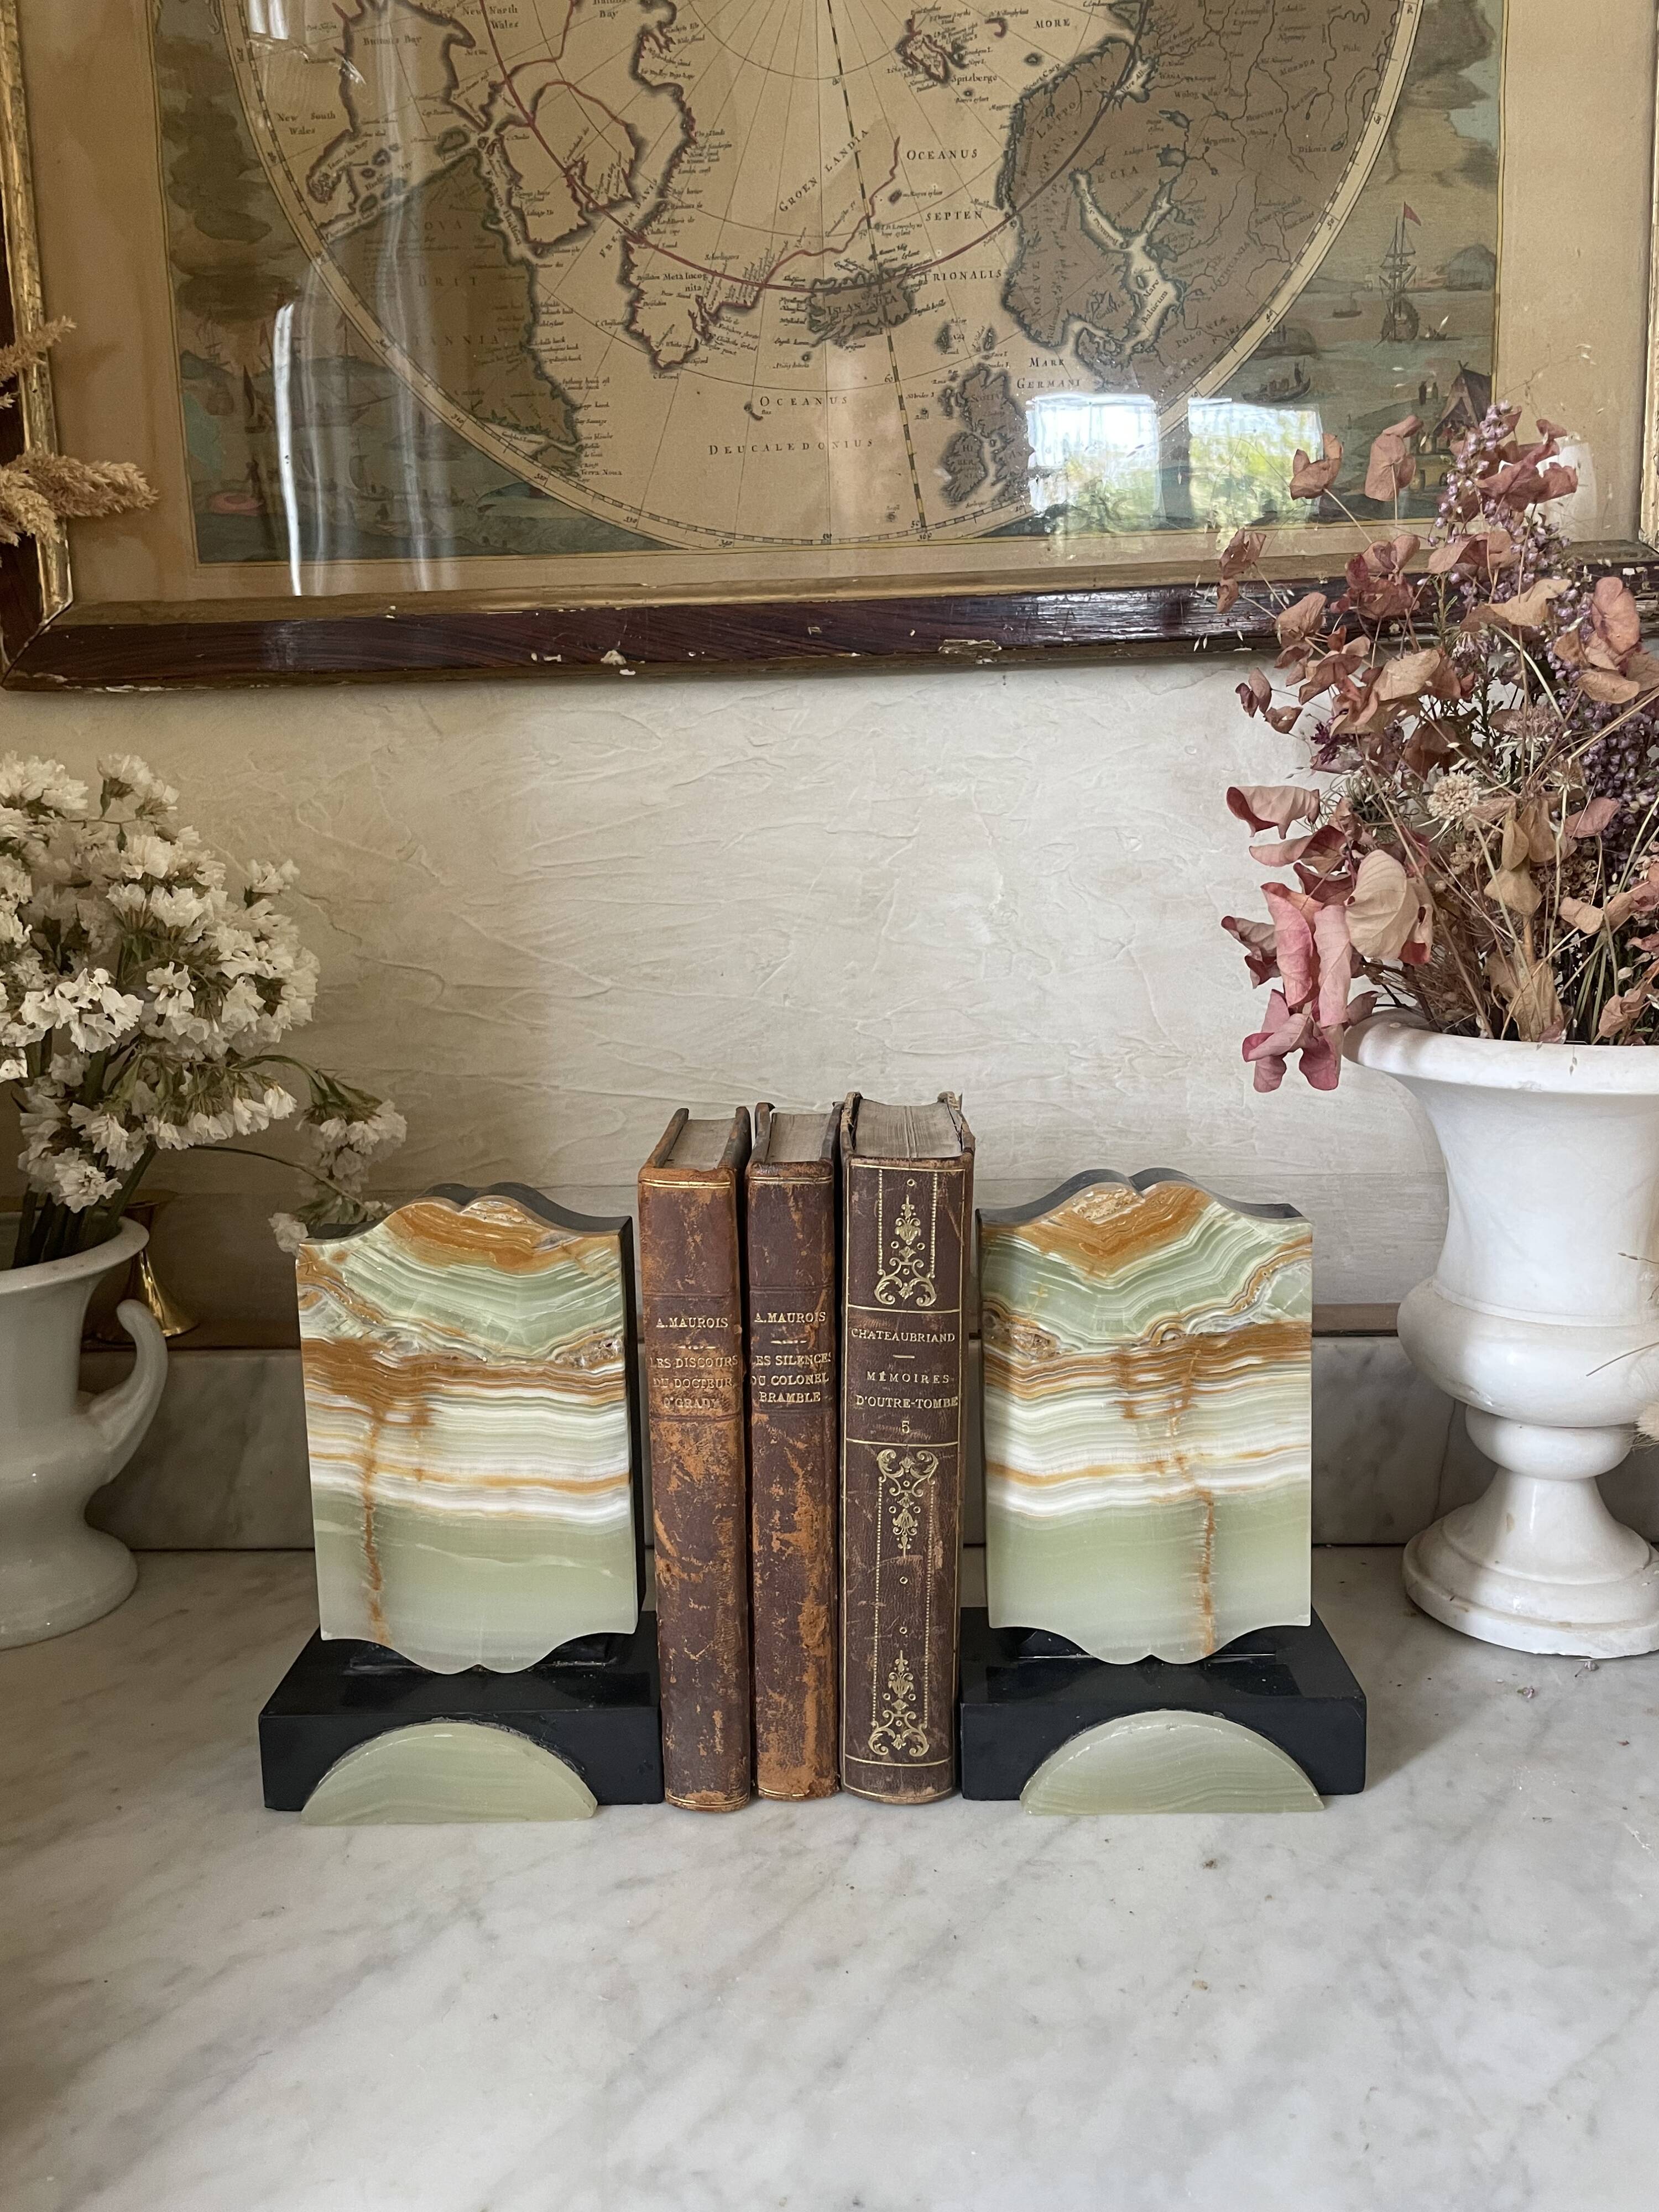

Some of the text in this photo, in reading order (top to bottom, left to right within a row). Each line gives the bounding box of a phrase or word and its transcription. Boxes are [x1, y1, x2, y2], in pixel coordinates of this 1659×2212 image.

[906, 149, 978, 160] OCEANUS
[925, 211, 983, 221] SEPTEN
[759, 396, 848, 407] OCEANUS
[708, 439, 874, 456] DEUCALEDONIUS
[656, 1317, 729, 1328] A.MAUROIS
[754, 1311, 827, 1323] A.MAUROIS
[851, 1328, 956, 1343] CHATEAUBRIAND
[650, 1355, 739, 1369] LES DISCOURS
[675, 1377, 733, 1390] DOCTEUR
[773, 1372, 830, 1386] COLONEL
[759, 1391, 821, 1404] BRAMBLE
[856, 1394, 958, 1409] D'OUTRE-TOMBE
[901, 1420, 910, 1434] 5
